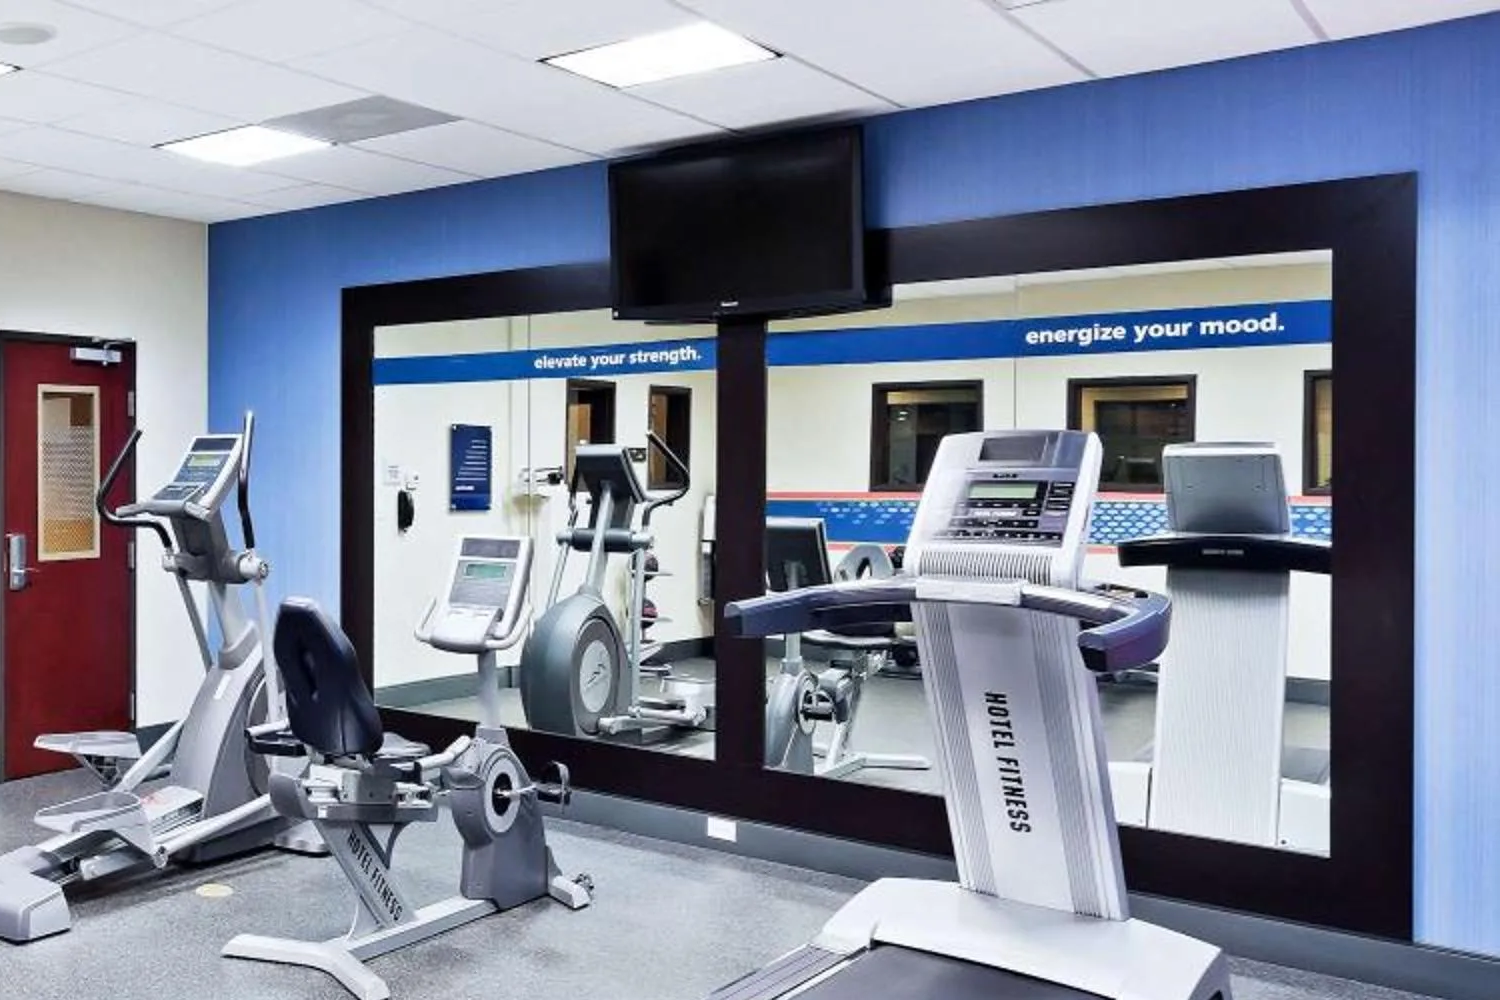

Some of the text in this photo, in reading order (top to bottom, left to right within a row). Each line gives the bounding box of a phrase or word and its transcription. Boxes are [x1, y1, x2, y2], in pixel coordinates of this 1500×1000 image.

[534, 346, 702, 370] elevate your strength.
[1025, 312, 1285, 346] energize your mood.
[985, 692, 1031, 833] HOTEL FITNESS
[348, 832, 403, 921] HOTEL FITNESS
